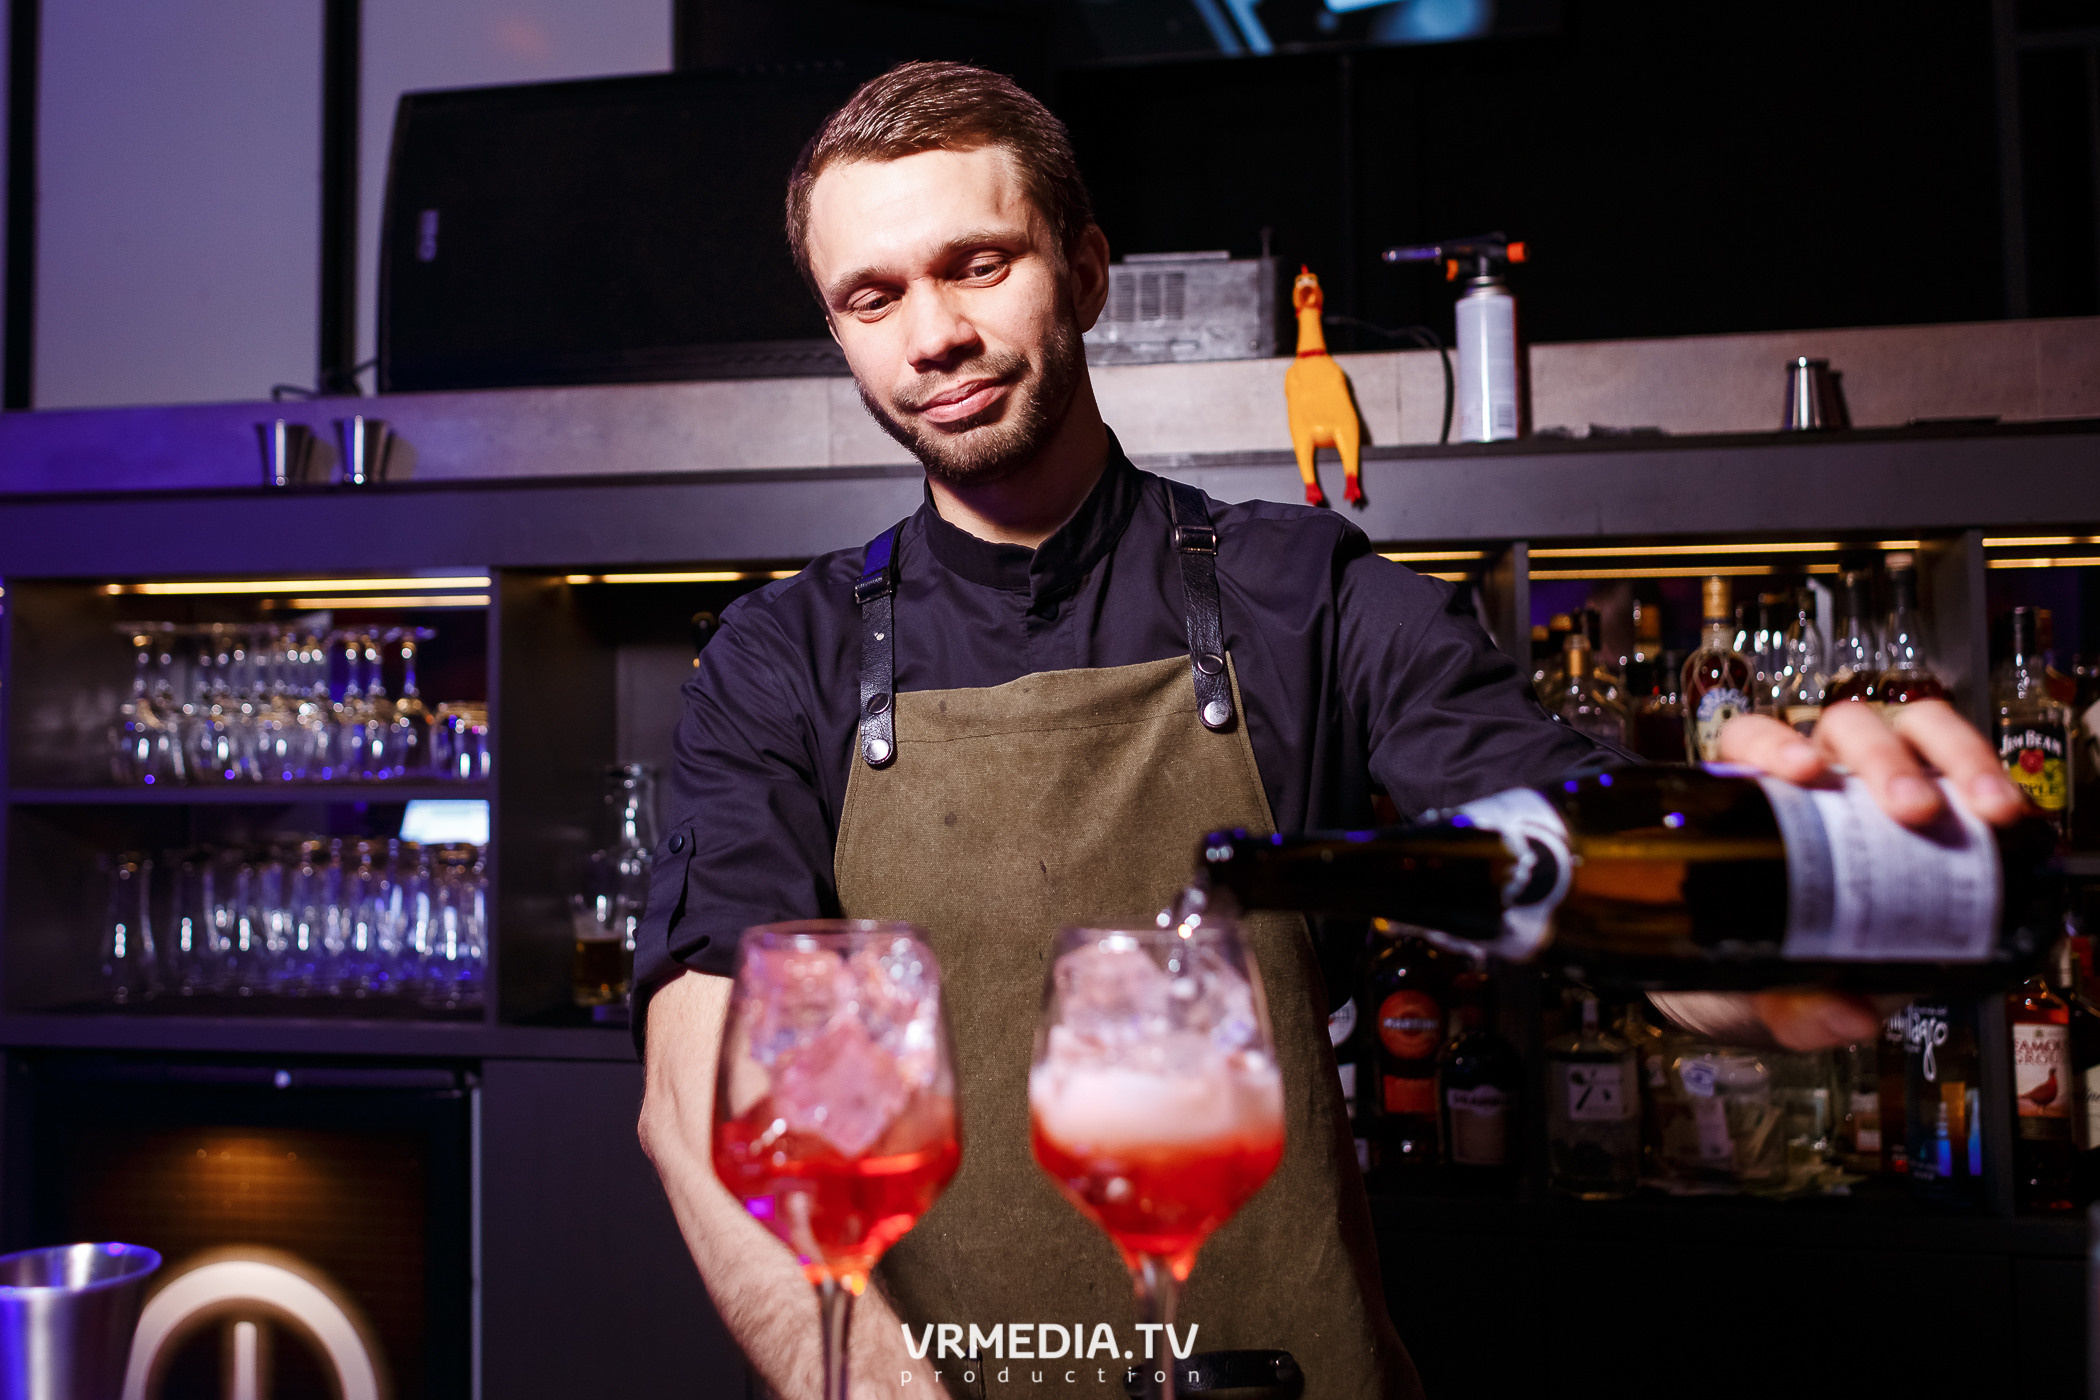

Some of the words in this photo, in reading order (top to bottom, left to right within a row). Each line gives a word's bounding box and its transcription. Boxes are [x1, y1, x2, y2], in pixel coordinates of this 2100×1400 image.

[1999, 733, 2024, 757] JIM
[2025, 729, 2063, 757] BEAM
[2017, 782, 2058, 796] PPLE
[2014, 1038, 2065, 1052] FAMOU
[2014, 1052, 2065, 1066] GROU
